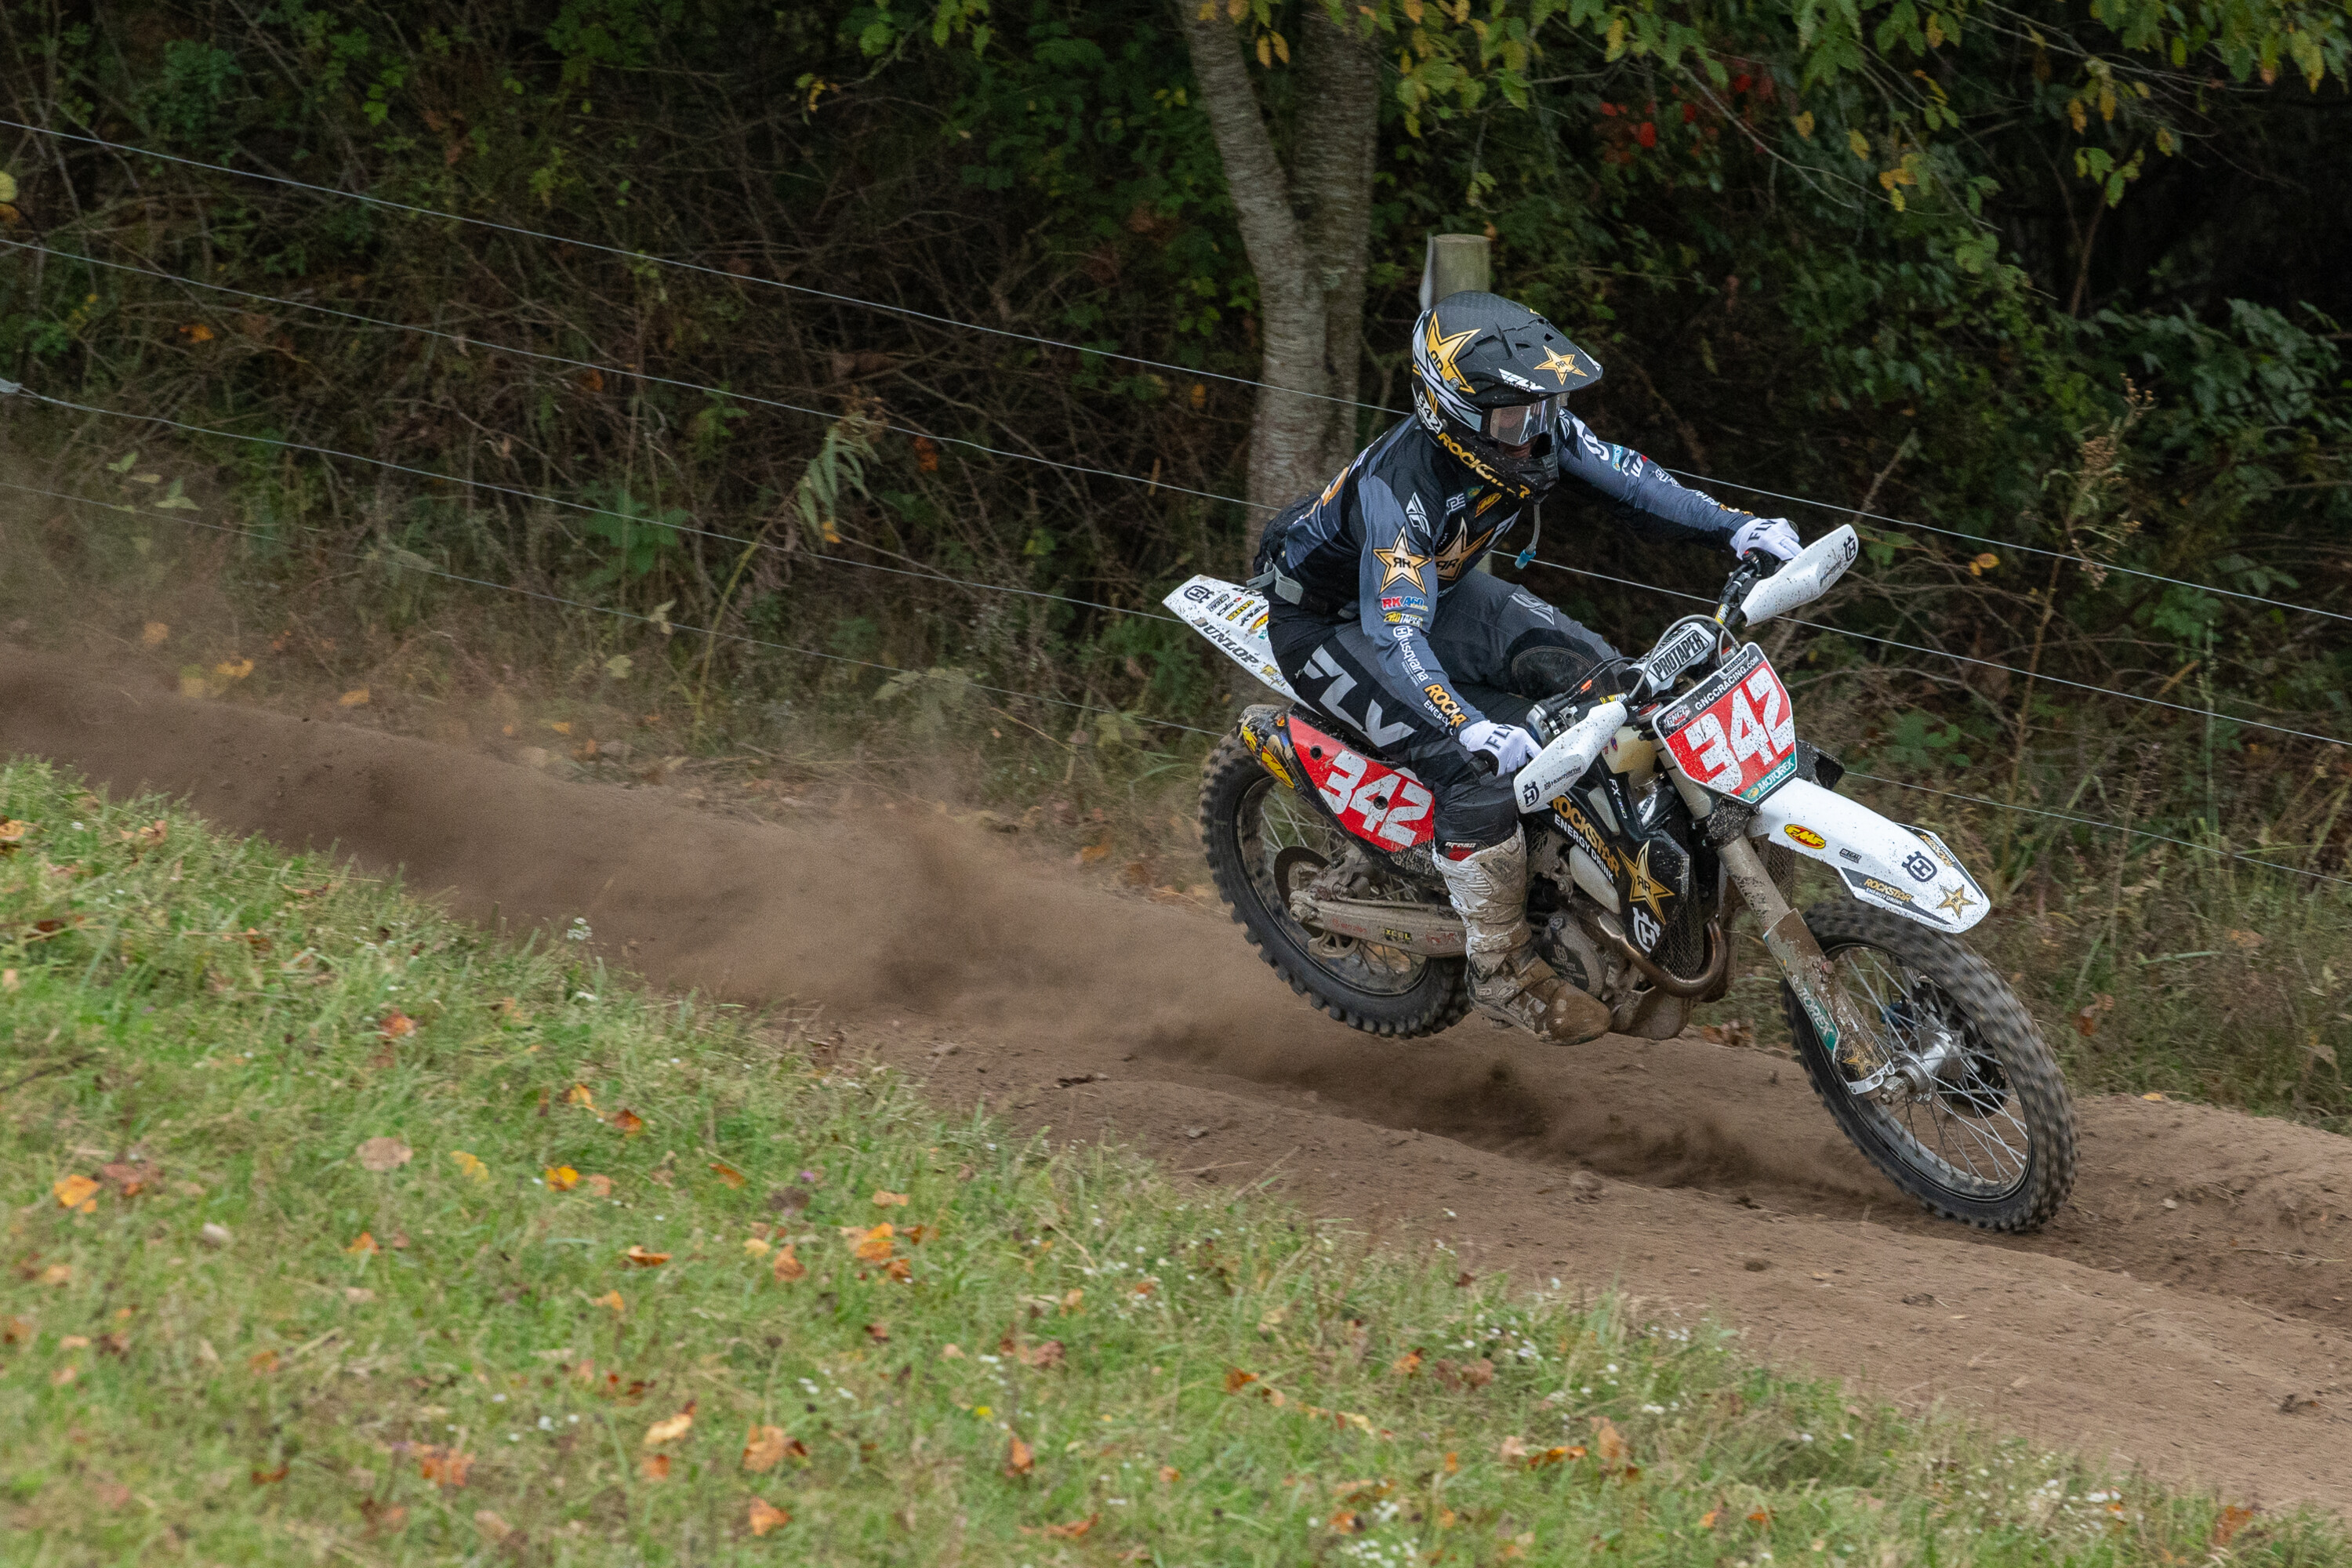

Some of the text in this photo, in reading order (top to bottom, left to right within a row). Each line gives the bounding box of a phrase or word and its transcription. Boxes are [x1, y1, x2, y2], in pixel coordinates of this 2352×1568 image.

[1417, 391, 1443, 434] 342
[1747, 518, 1779, 543] FLY
[1652, 630, 1704, 679] PROTAPER
[1483, 724, 1515, 751] FLY
[1683, 666, 1795, 793] 342
[1609, 779, 1621, 797] FX
[1757, 757, 1794, 790] MOTOREX
[1319, 750, 1433, 848] 342
[1554, 813, 1614, 884] ENERGY DRINK
[1785, 825, 1825, 846] FMF
[1864, 878, 1913, 903] ROCKSTAR
